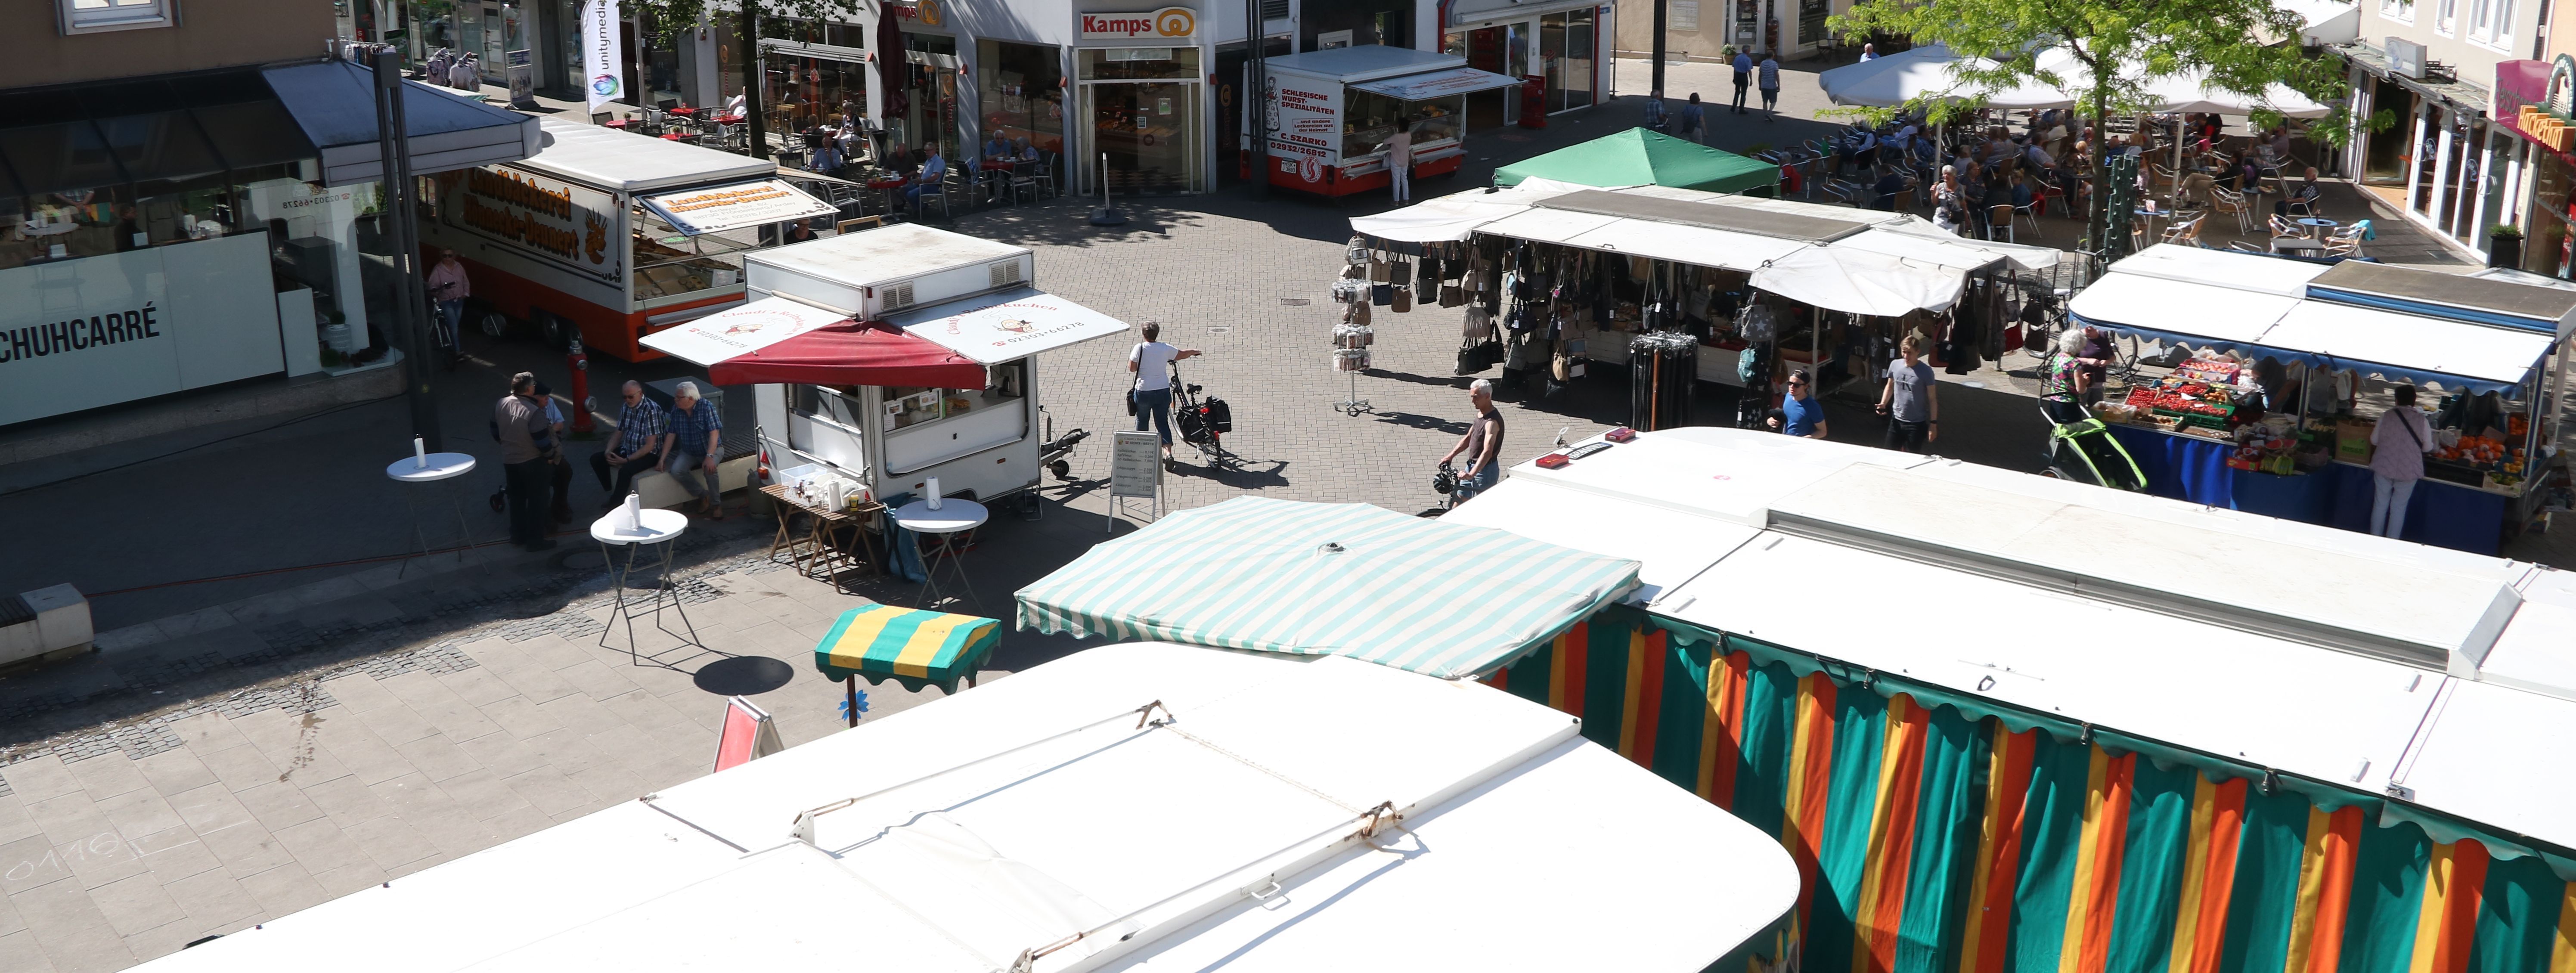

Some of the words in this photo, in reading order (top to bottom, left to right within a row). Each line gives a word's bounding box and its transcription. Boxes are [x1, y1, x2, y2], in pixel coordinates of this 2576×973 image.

[1083, 15, 1152, 36] Kamps
[1281, 95, 1307, 104] WURST-
[1282, 89, 1328, 101] SCHLESISCHE
[1281, 101, 1334, 115] SPEZIALITÄTEN
[2517, 105, 2568, 152] Hackethal
[1290, 134, 1327, 147] SZARKO
[1270, 142, 1326, 158] 02932/26812
[468, 166, 571, 222] Landbäckerei
[664, 186, 778, 207] Landbäckerei
